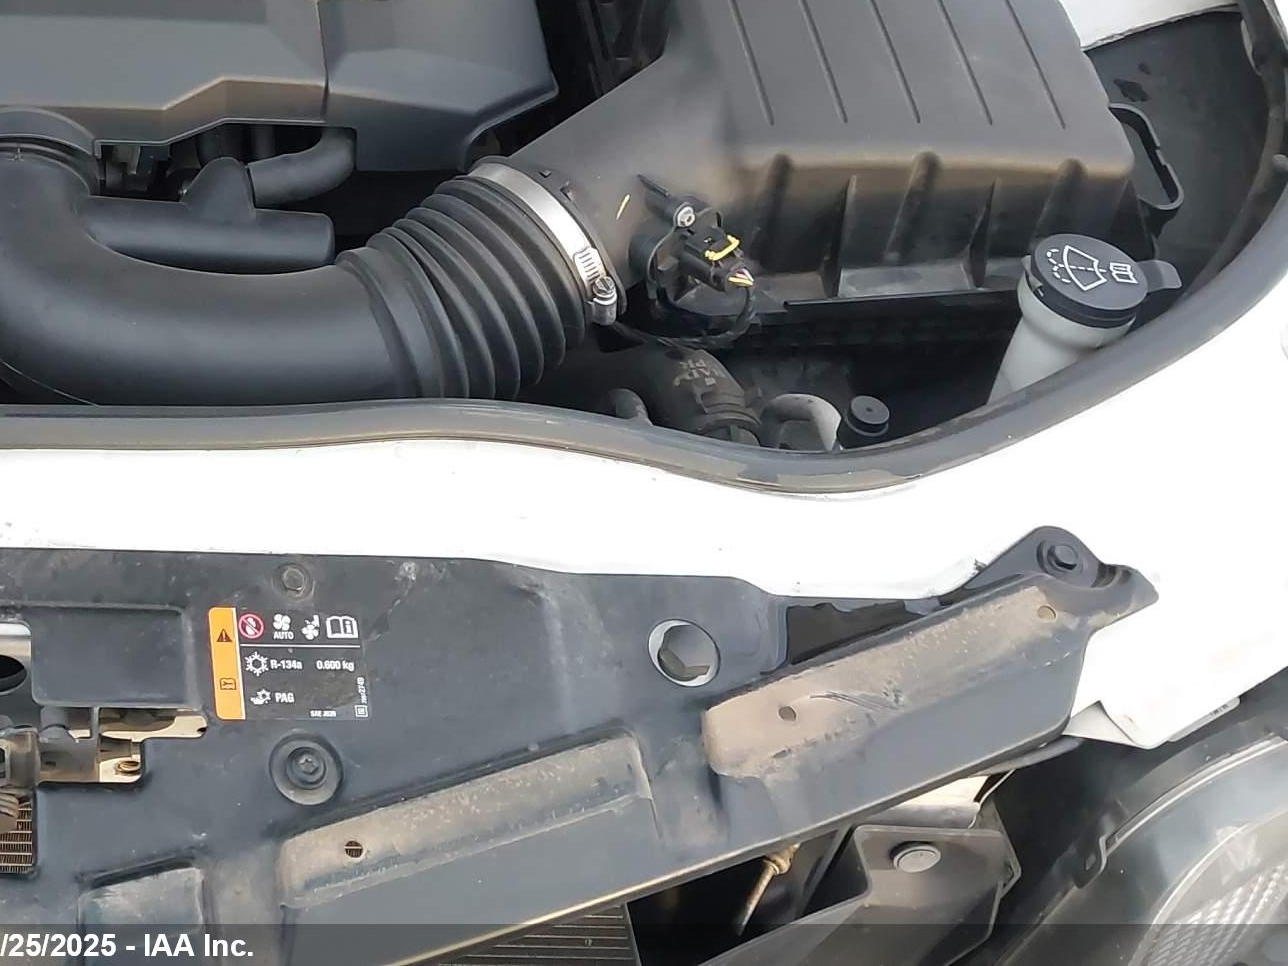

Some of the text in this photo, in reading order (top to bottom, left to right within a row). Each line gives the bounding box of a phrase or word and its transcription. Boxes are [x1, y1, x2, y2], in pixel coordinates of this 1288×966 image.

[273, 631, 295, 640] AUTO
[270, 659, 355, 672] R-134a 0.600 kg
[275, 692, 295, 703] PAG
